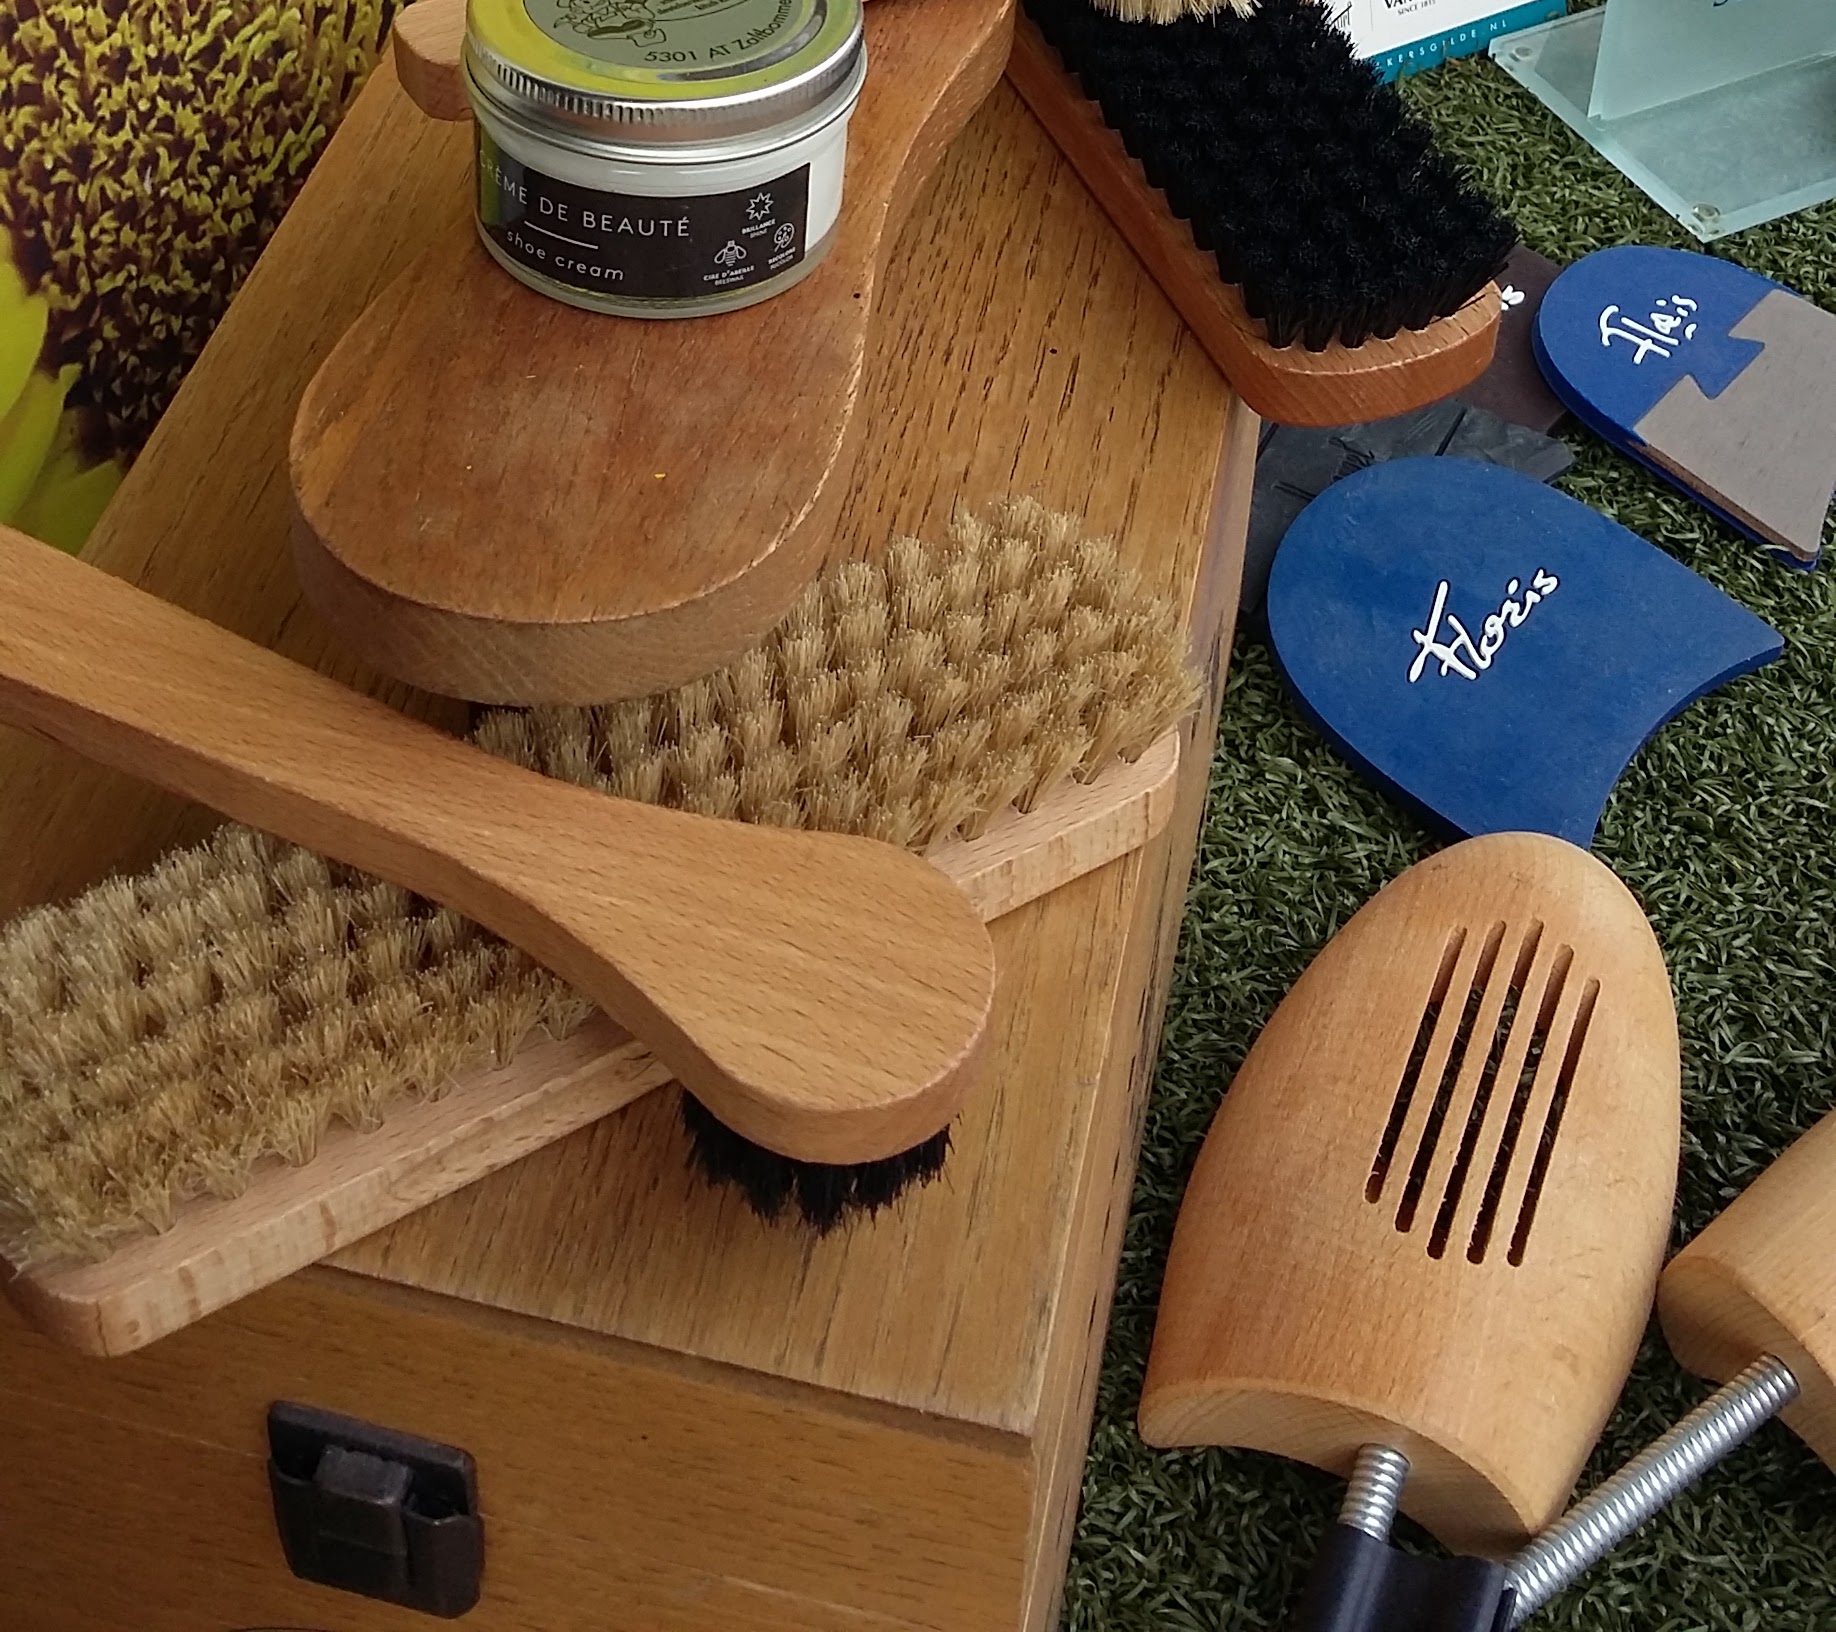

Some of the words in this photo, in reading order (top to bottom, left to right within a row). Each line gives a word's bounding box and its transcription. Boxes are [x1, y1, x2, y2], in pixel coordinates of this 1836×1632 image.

[1397, 5, 1419, 16] SINCE
[644, 50, 697, 63] 5301
[709, 45, 731, 60] AT
[480, 149, 528, 205] CRÈME
[539, 196, 569, 222] DE
[582, 210, 690, 237] BEAUTÉ
[506, 230, 546, 259] shoe
[555, 255, 624, 281] cream
[1408, 568, 1560, 683] Floris
